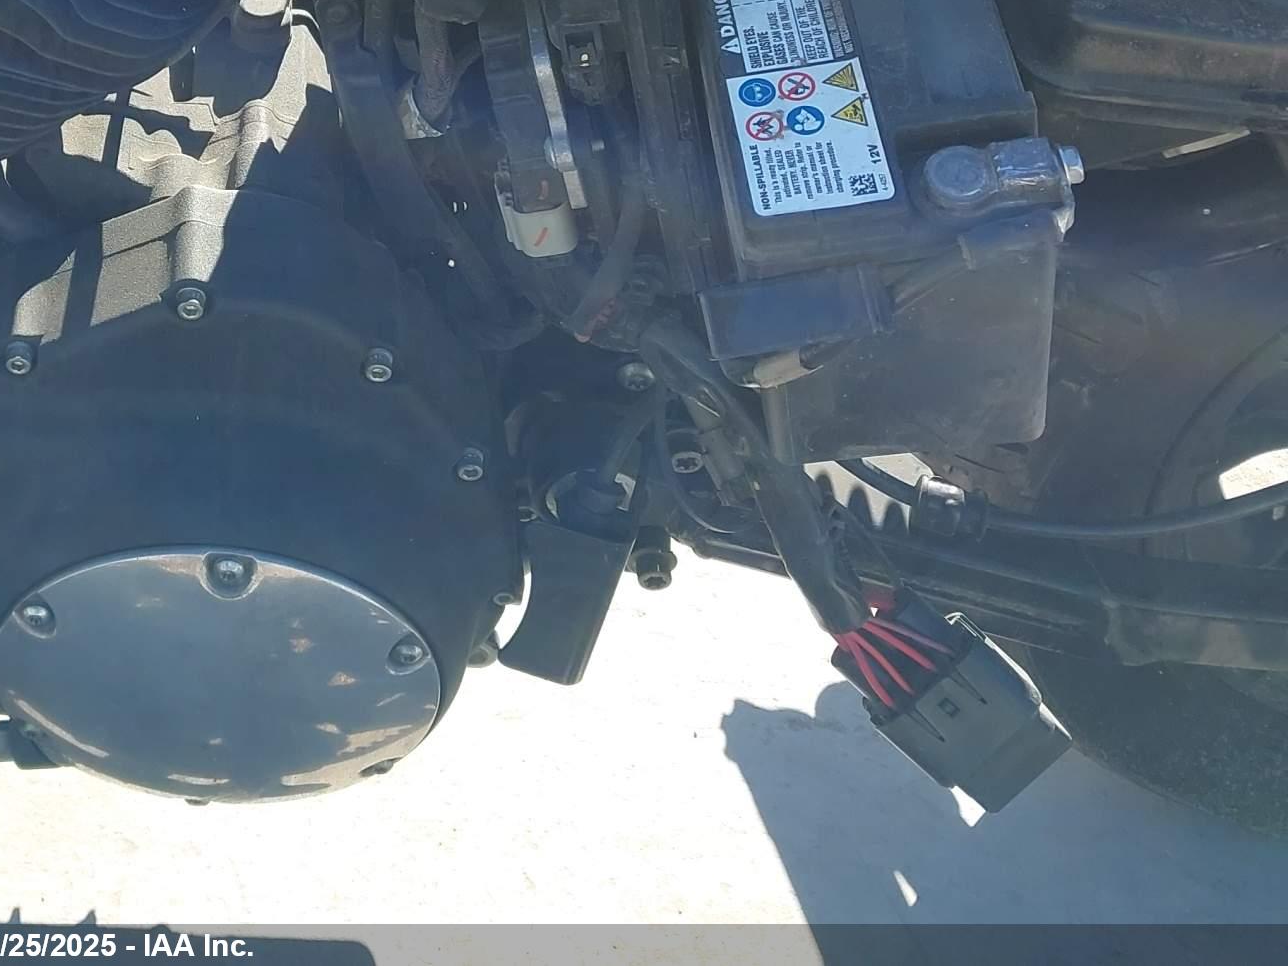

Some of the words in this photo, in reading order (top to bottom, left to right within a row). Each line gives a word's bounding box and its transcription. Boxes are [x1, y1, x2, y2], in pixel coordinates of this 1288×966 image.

[767, 12, 779, 30] CAUSE
[795, 6, 807, 19] THE
[782, 22, 792, 30] OR
[798, 20, 810, 28] OF
[811, 27, 823, 36] OF
[772, 31, 783, 43] CAN
[801, 30, 814, 43] OUT
[757, 32, 775, 66] EXPLOSIVE
[773, 43, 788, 65] GASES
[805, 44, 817, 60] KEEP
[814, 37, 829, 59] REACH
[747, 46, 762, 69] SHIELD
[815, 142, 823, 150] for
[867, 144, 881, 164] 12V
[774, 150, 786, 170] SEALED
[785, 150, 796, 168] NEVER
[796, 149, 805, 164] Refer
[807, 152, 817, 172] manual
[817, 150, 826, 165] sheet
[749, 145, 770, 210] NON-SPILLABLE
[833, 169, 844, 193] charging
[774, 191, 782, 203] This
[804, 179, 813, 199] remove
